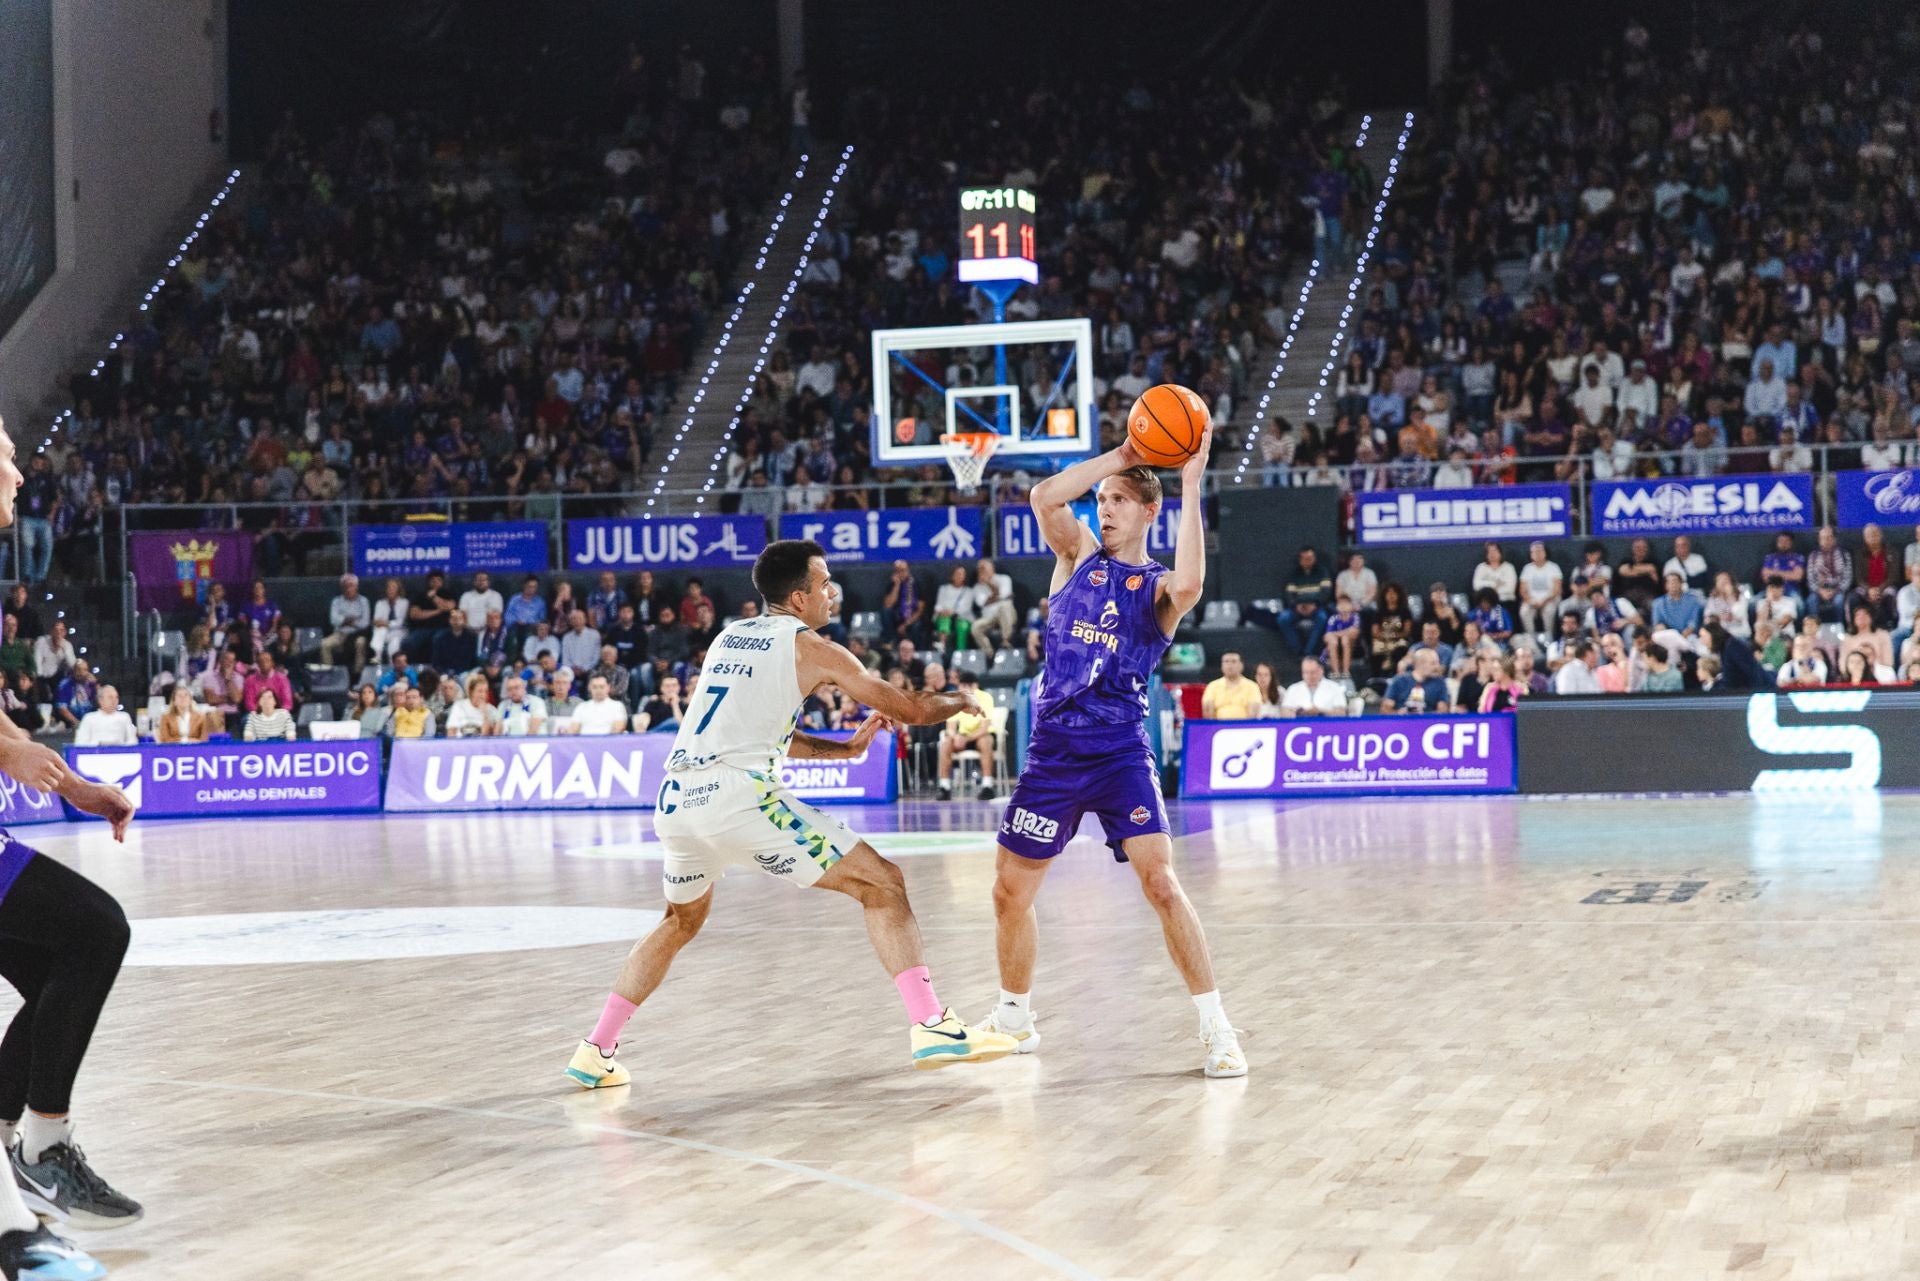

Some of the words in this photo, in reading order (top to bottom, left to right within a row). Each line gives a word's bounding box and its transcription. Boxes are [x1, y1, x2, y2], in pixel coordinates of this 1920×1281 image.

[966, 222, 1008, 258] 11
[1362, 494, 1564, 527] clomar
[576, 524, 699, 564] JULUIS
[803, 511, 911, 550] raiz
[719, 634, 775, 651] FIGUERAS
[695, 686, 729, 735] 7
[1284, 727, 1409, 768] Grupo
[1422, 723, 1489, 759] CFI
[152, 751, 370, 782] DENTOMEDIC
[424, 744, 643, 803] URMAN
[258, 786, 327, 801] DENTALES
[1012, 807, 1059, 838] gaza
